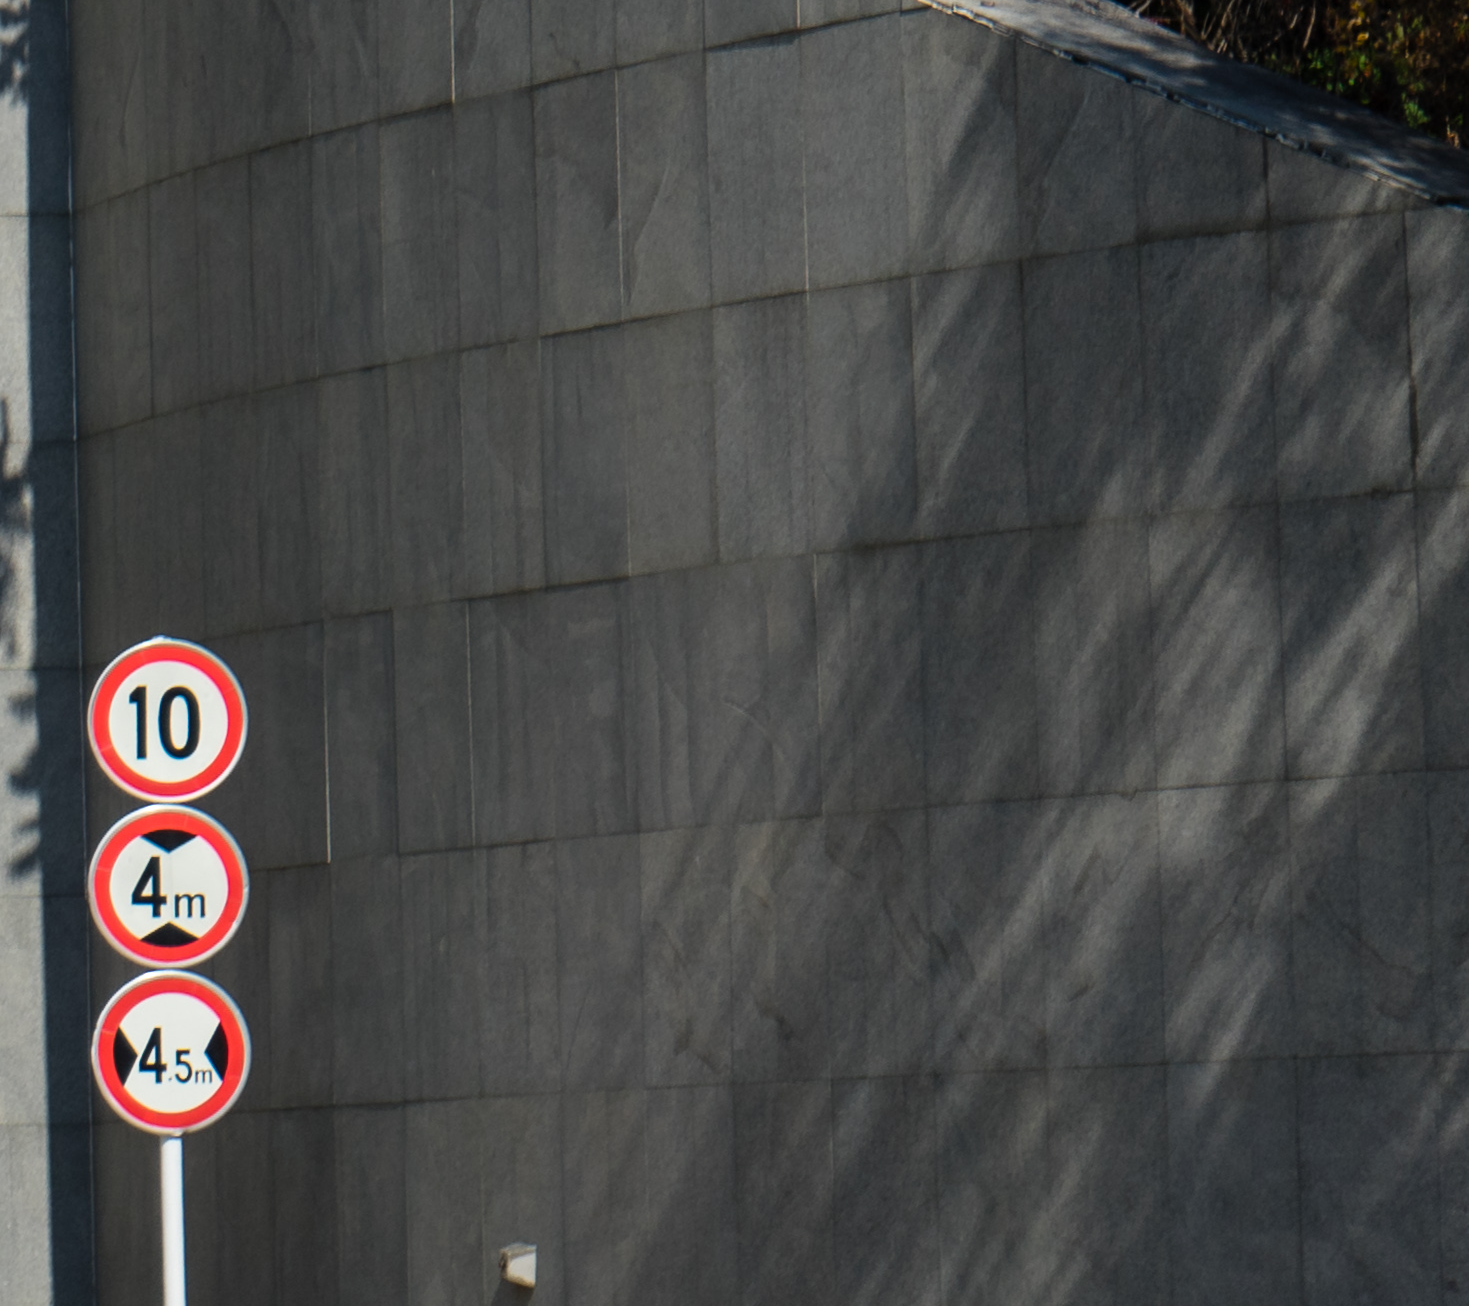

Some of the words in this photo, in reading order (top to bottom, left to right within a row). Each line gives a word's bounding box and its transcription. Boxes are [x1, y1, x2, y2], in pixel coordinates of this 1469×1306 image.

[128, 685, 201, 760] 10
[131, 855, 207, 919] 4m
[138, 1026, 213, 1085] 4.5m
